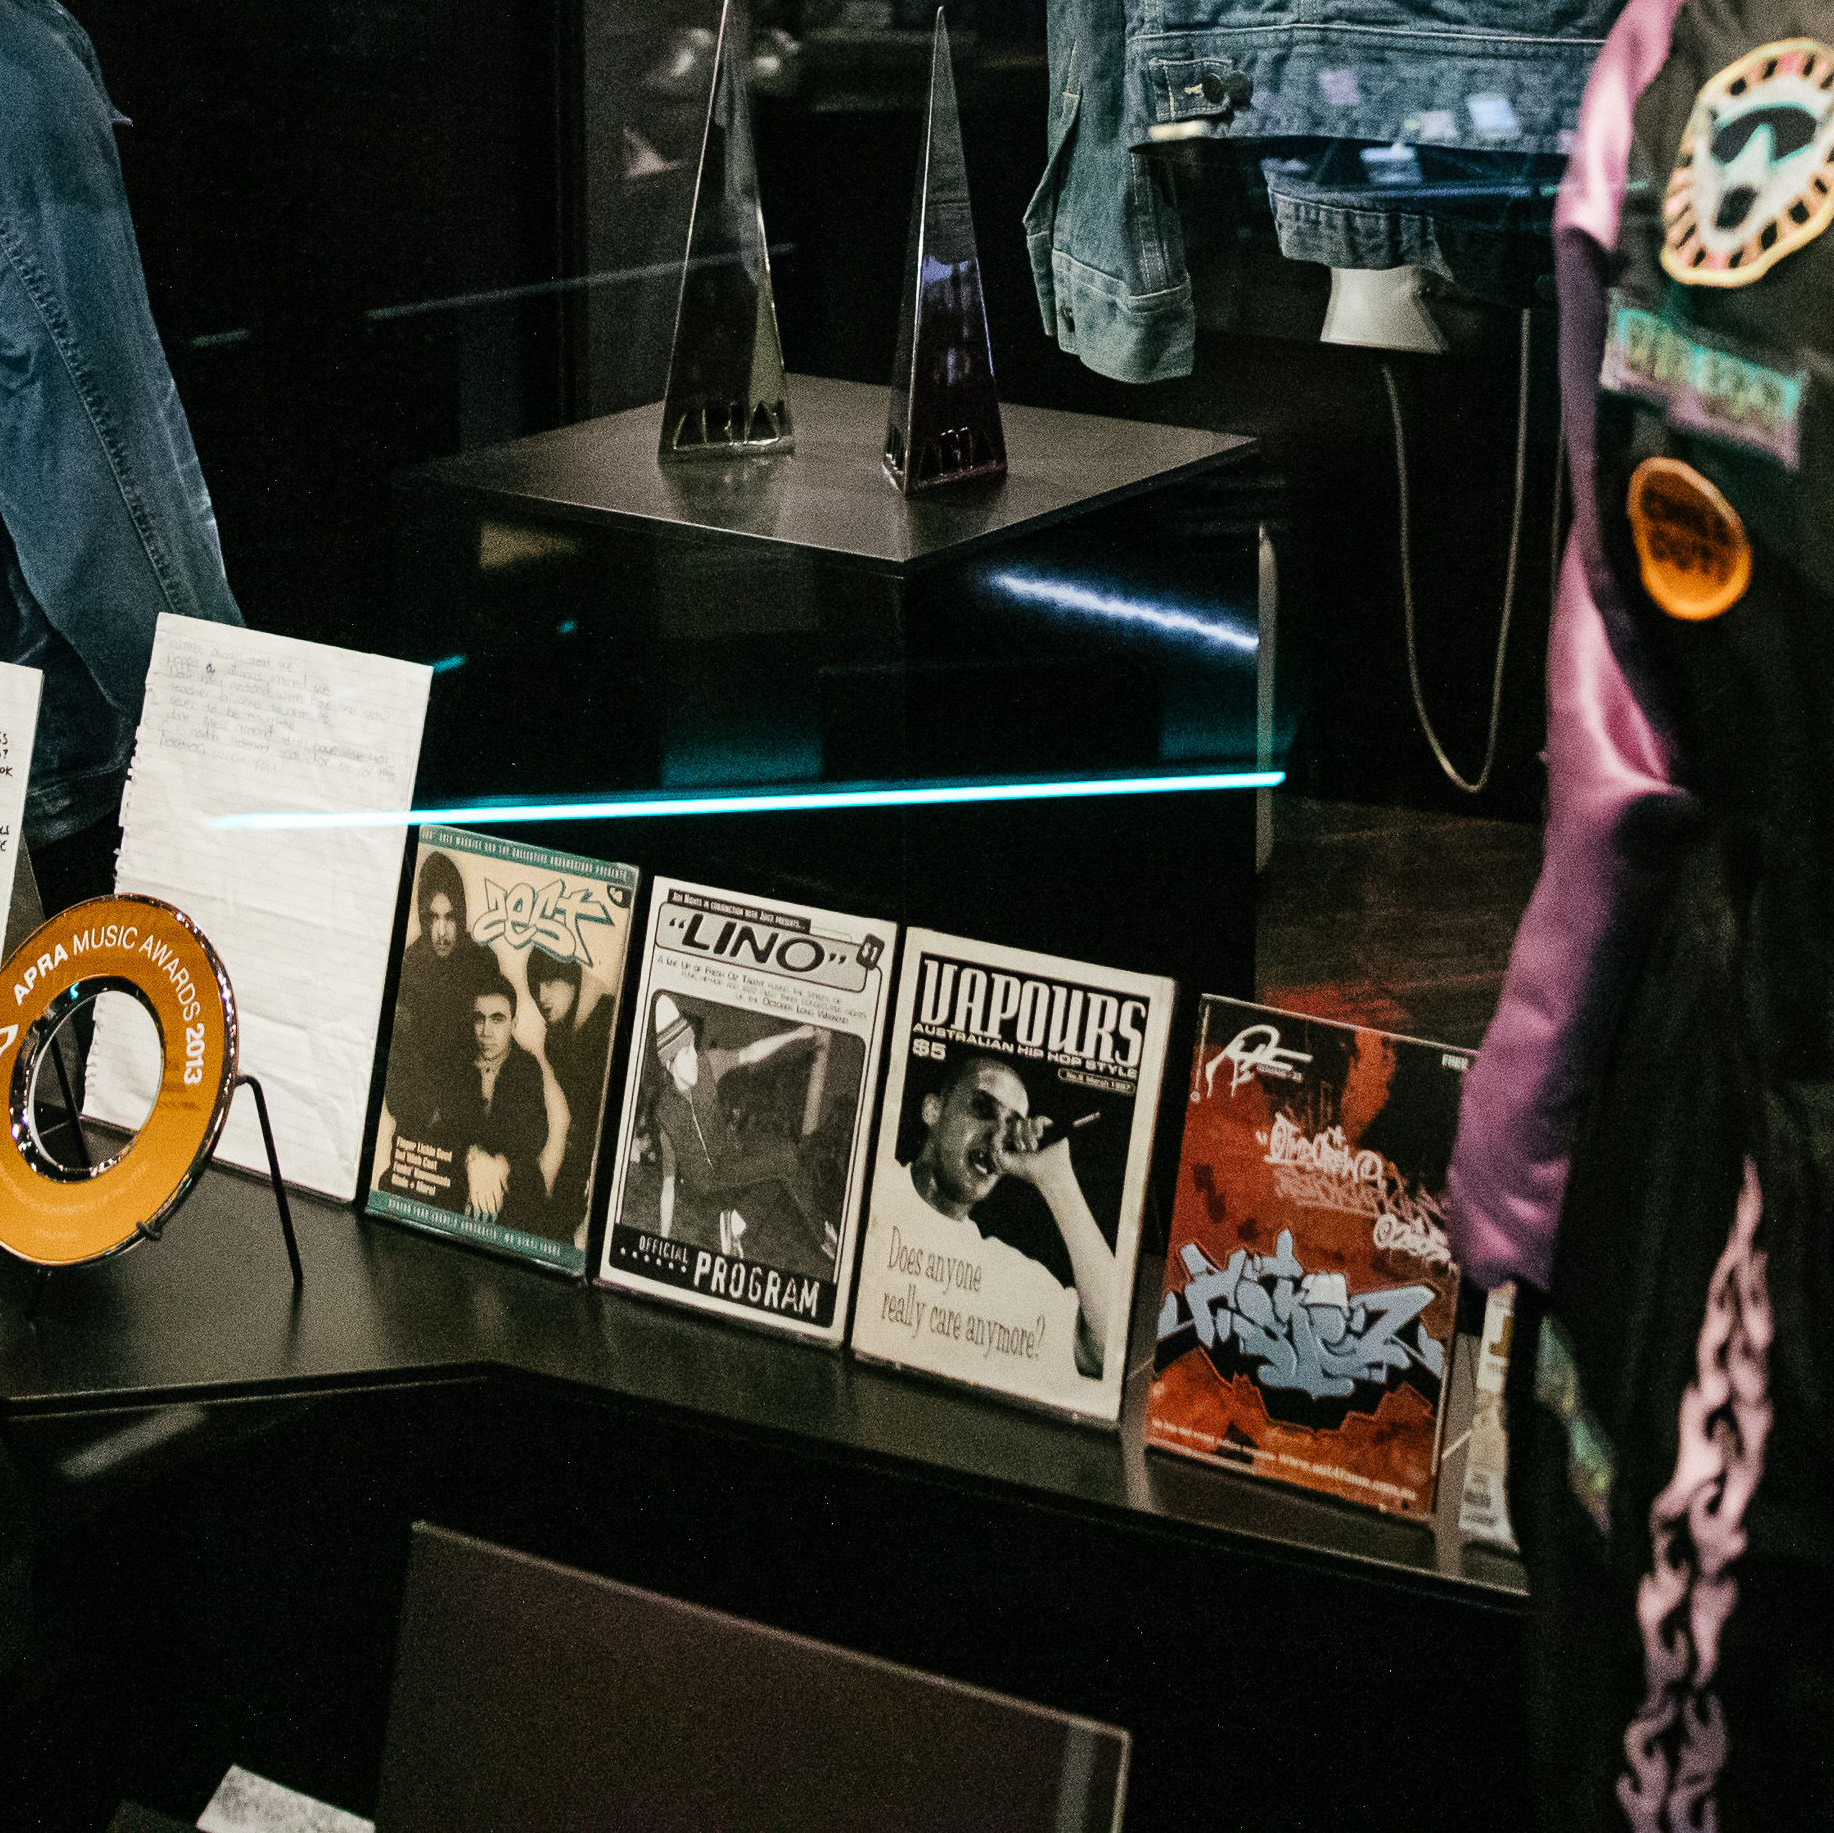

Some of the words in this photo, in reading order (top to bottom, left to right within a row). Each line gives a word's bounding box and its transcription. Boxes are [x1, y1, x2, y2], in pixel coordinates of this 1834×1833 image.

[12, 942, 69, 1007] APRA
[71, 924, 139, 957] MUSIC
[138, 933, 202, 1023] AWARDS
[182, 1021, 207, 1086] 2013
[919, 958, 1148, 1069] VAPOURS
[911, 1037, 947, 1062] $5
[912, 1022, 1015, 1055] AUSTRALIAN
[1016, 1043, 1045, 1060] HIP
[1047, 1050, 1083, 1067] HOP
[1085, 1058, 1140, 1079] STYLE
[638, 1234, 689, 1265] OFFICIAL
[693, 1249, 821, 1318] PROGRAM
[886, 1224, 924, 1277] Does
[924, 1252, 983, 1296] anyone
[880, 1283, 928, 1340] really
[928, 1305, 963, 1341] care
[964, 1313, 1047, 1360] anymore?
